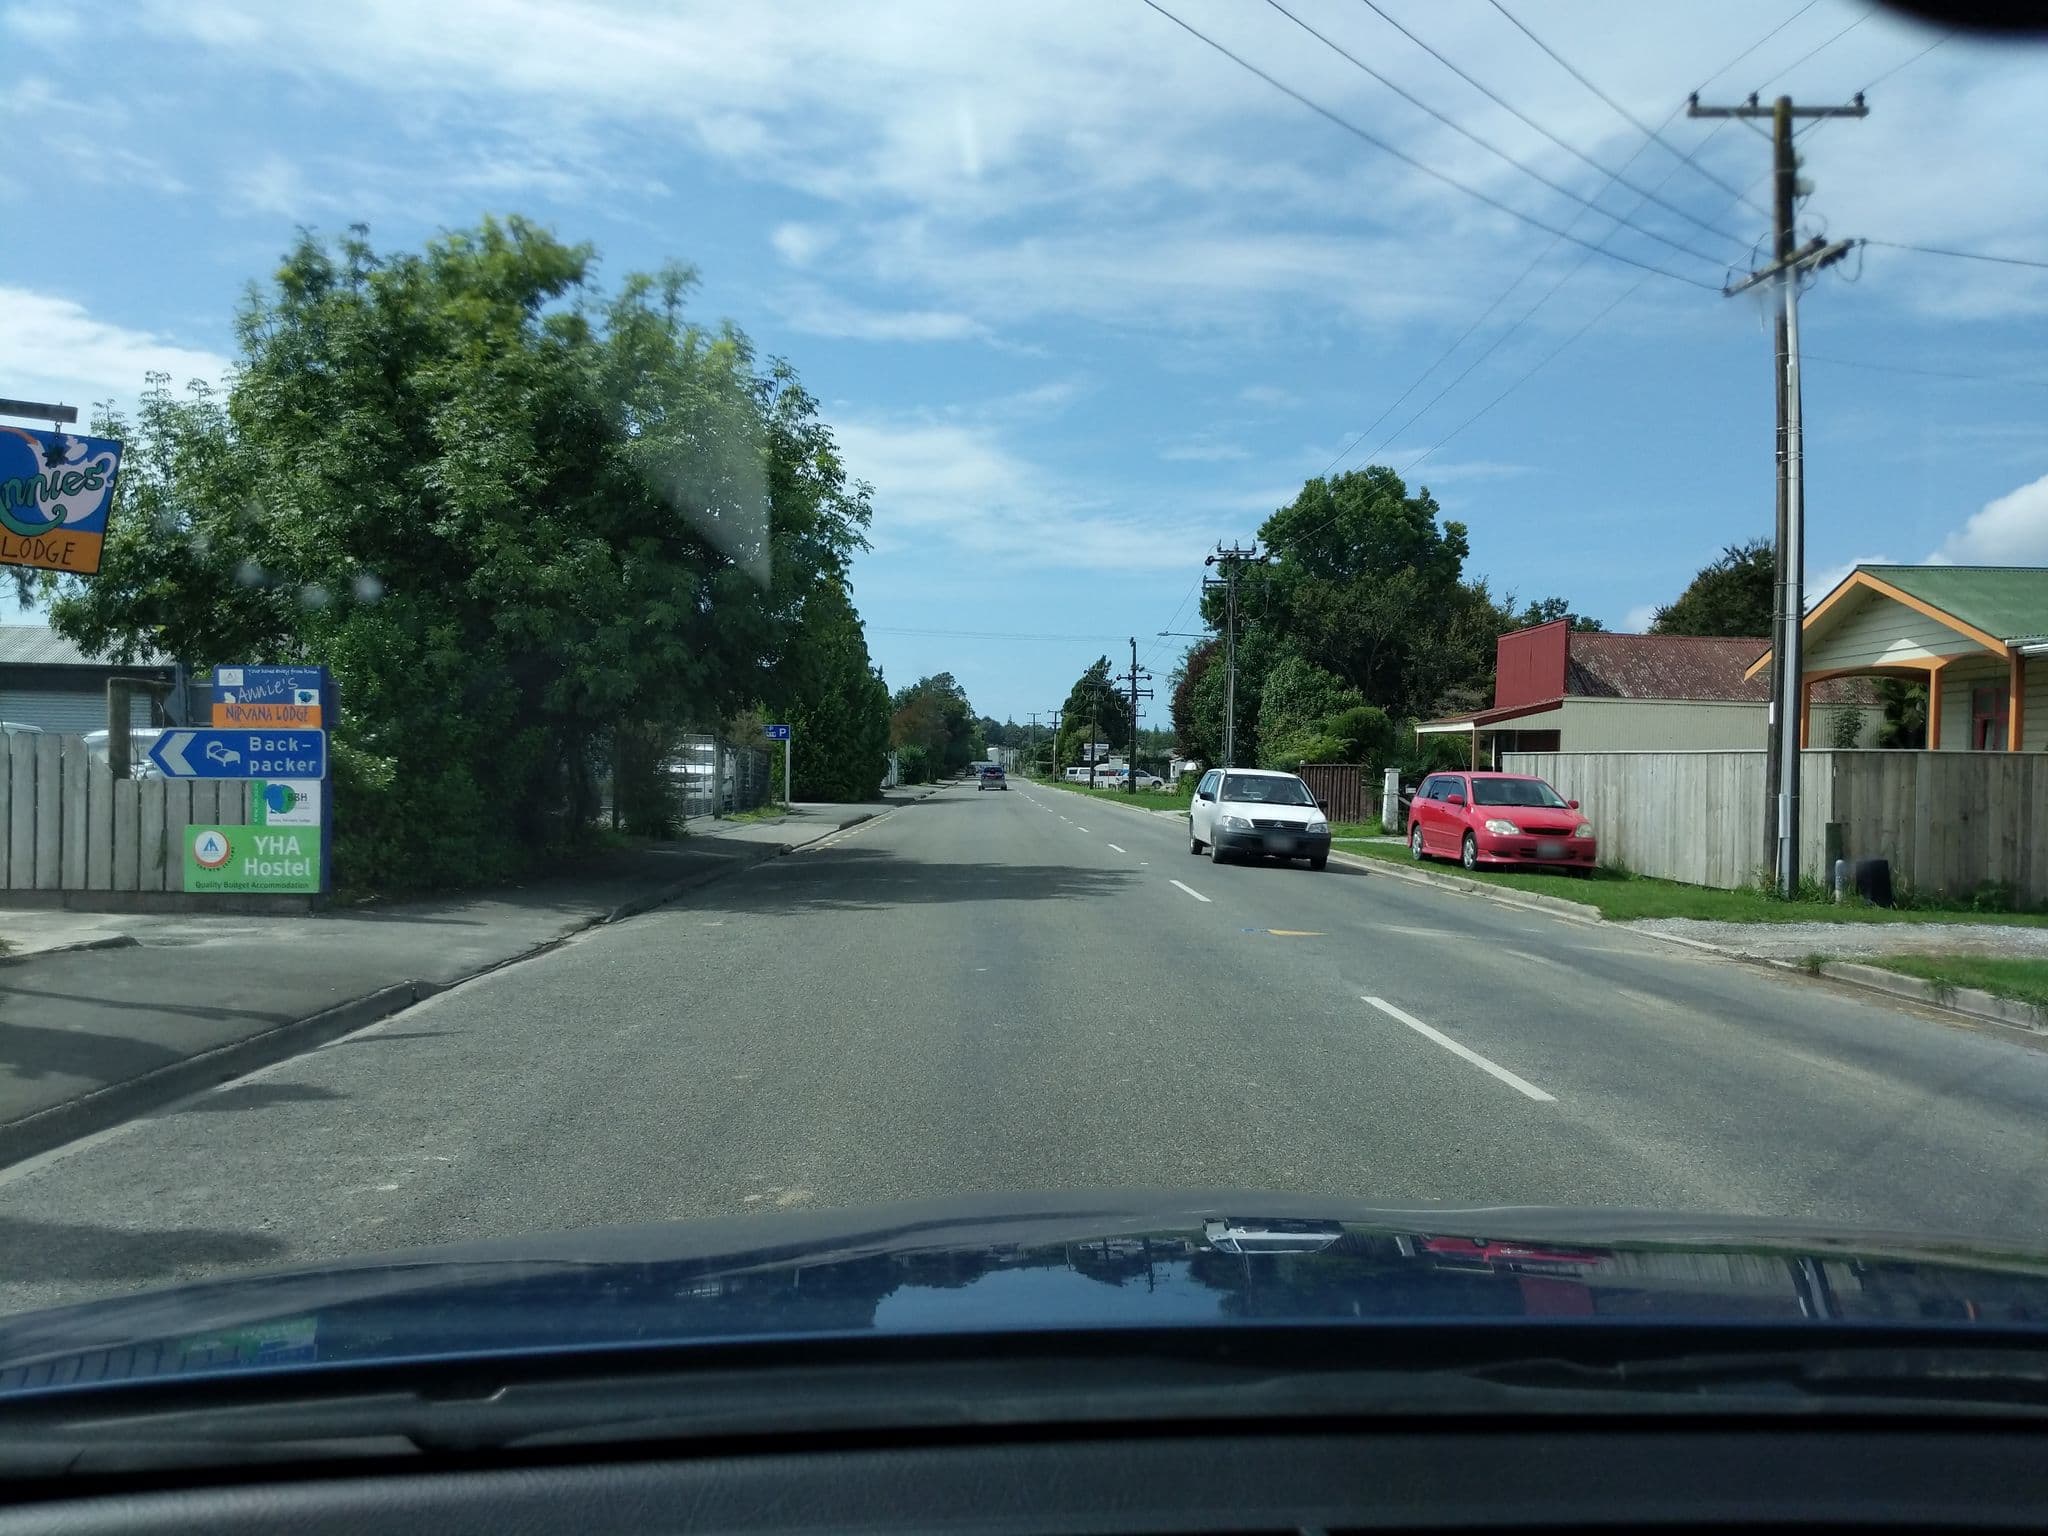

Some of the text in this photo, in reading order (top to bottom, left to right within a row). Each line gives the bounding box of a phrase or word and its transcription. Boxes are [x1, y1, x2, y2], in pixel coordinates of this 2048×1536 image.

[0, 463, 104, 510] nnies
[1, 536, 76, 566] LODGE
[237, 677, 299, 704] Annie's
[225, 705, 309, 722] NIRVANA LODGE
[779, 728, 787, 737] P
[250, 737, 312, 752] Back-
[250, 757, 317, 775] packer
[254, 835, 301, 856] YHA
[244, 857, 311, 877] Hostel
[195, 881, 309, 890] Quality Budget Accommodation
